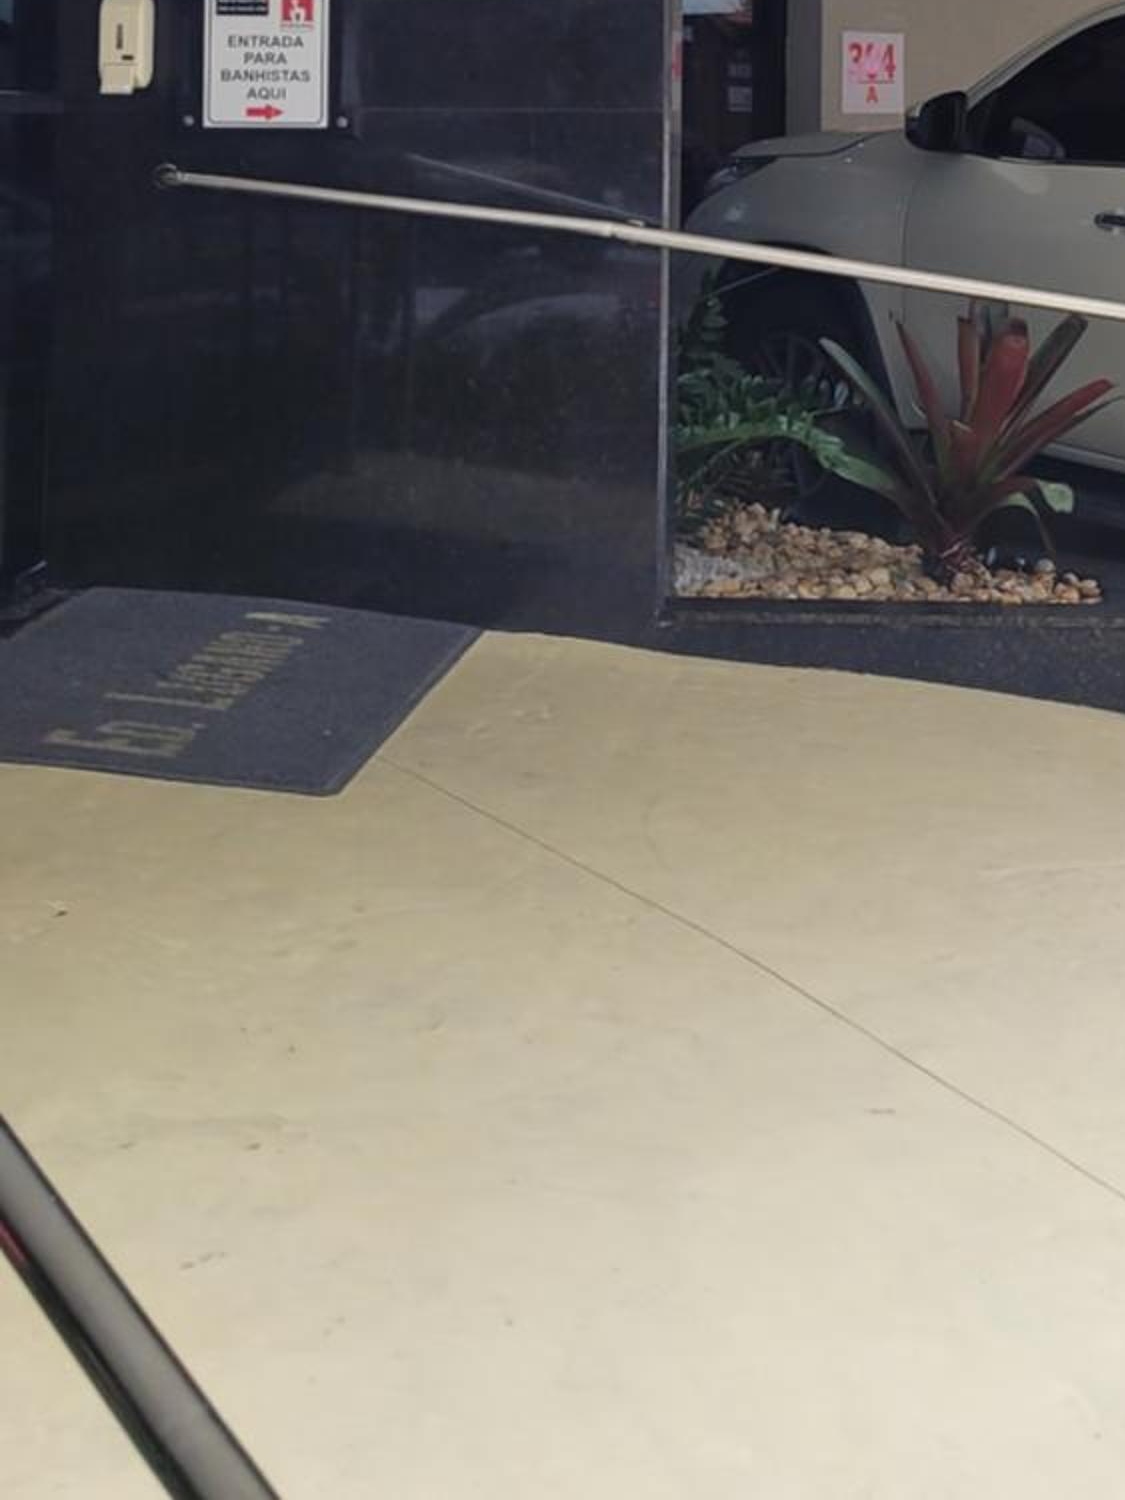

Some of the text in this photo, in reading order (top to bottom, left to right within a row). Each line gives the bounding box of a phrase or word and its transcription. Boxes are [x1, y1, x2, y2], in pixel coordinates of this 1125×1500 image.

[227, 34, 304, 48] ENTRADA
[243, 51, 288, 65] PARA
[219, 69, 311, 82] BANHISTAS
[246, 86, 287, 100] AQUI
[865, 84, 879, 104] A
